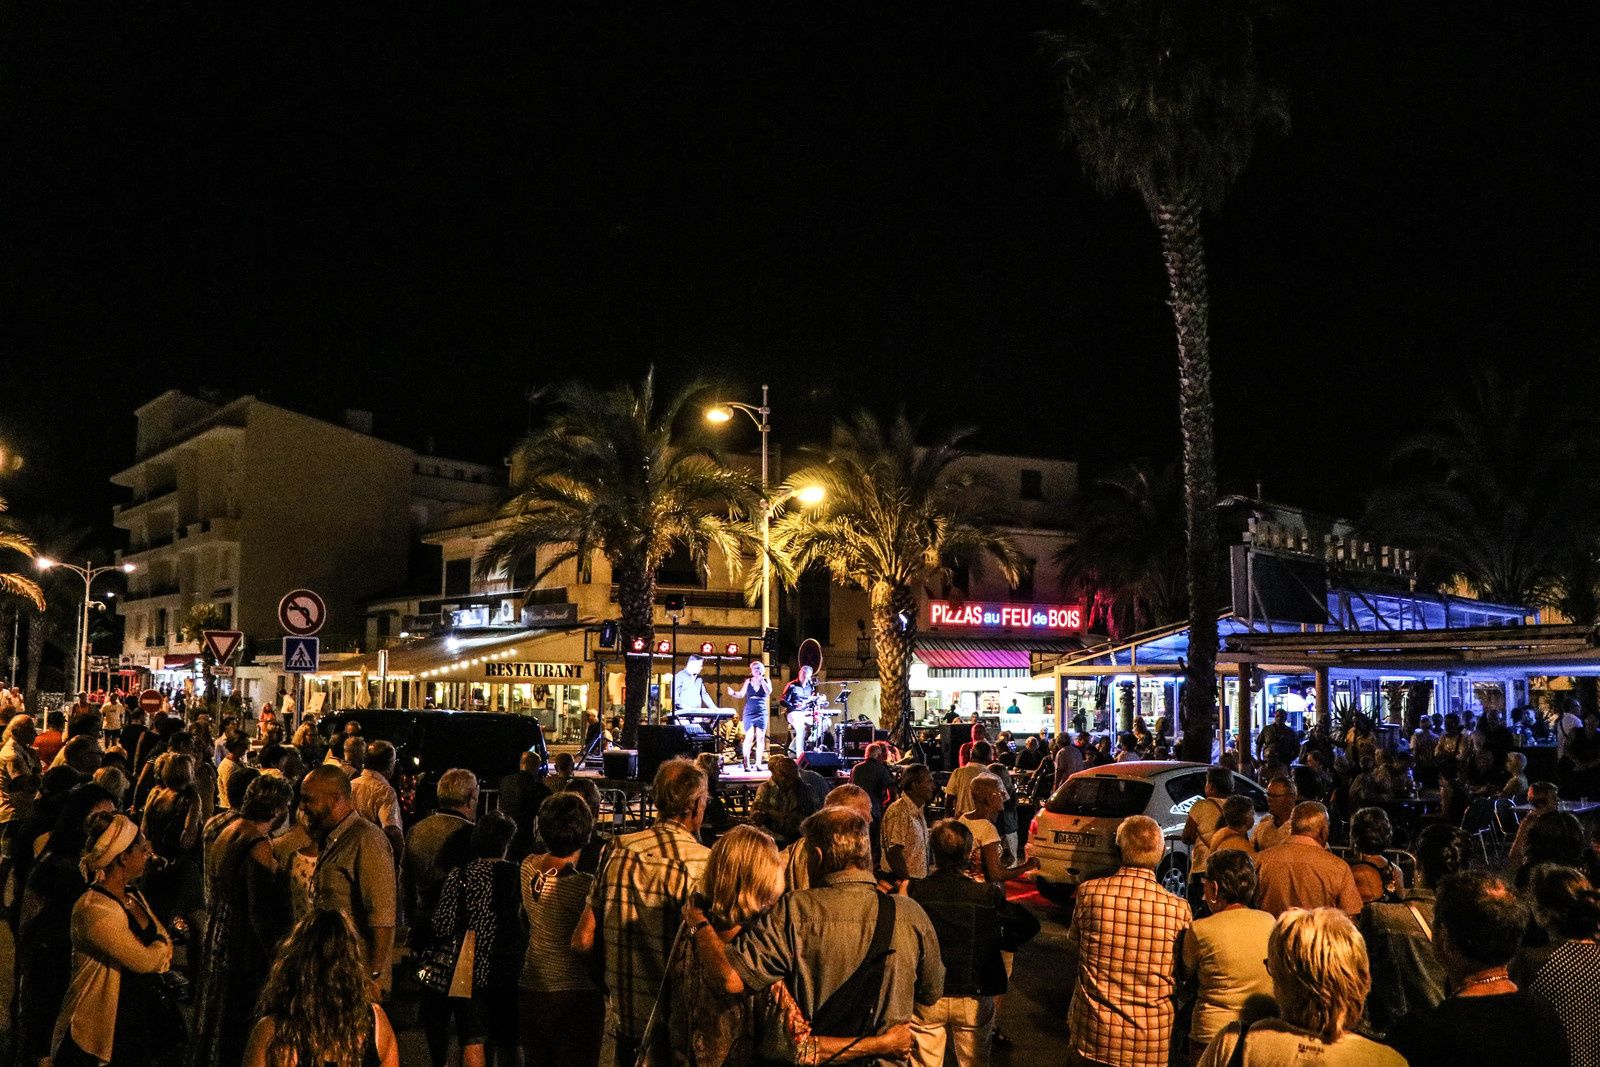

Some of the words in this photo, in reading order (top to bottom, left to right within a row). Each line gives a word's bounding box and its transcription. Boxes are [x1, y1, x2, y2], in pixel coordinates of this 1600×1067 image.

[984, 612, 1000, 624] au
[1002, 608, 1032, 627] FEU
[1032, 612, 1048, 625] de
[1049, 609, 1080, 628] BOIS
[485, 662, 584, 678] RESTAURANT
